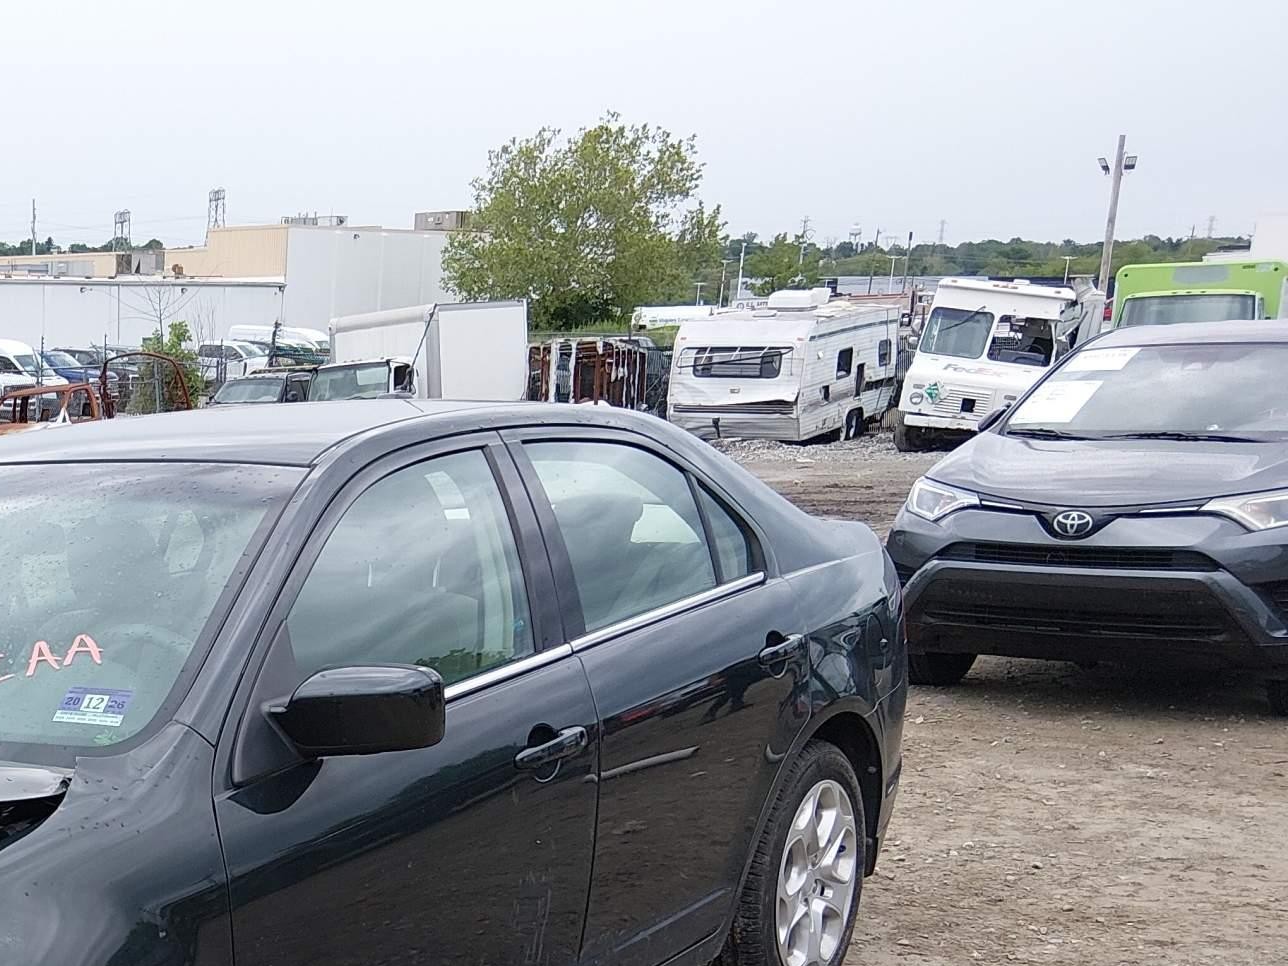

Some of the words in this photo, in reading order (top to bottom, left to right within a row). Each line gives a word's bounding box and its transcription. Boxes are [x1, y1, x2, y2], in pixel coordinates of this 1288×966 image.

[943, 363, 1008, 377] FedEx
[65, 697, 81, 706] 20
[84, 696, 105, 710] 12
[108, 700, 126, 709] 26
